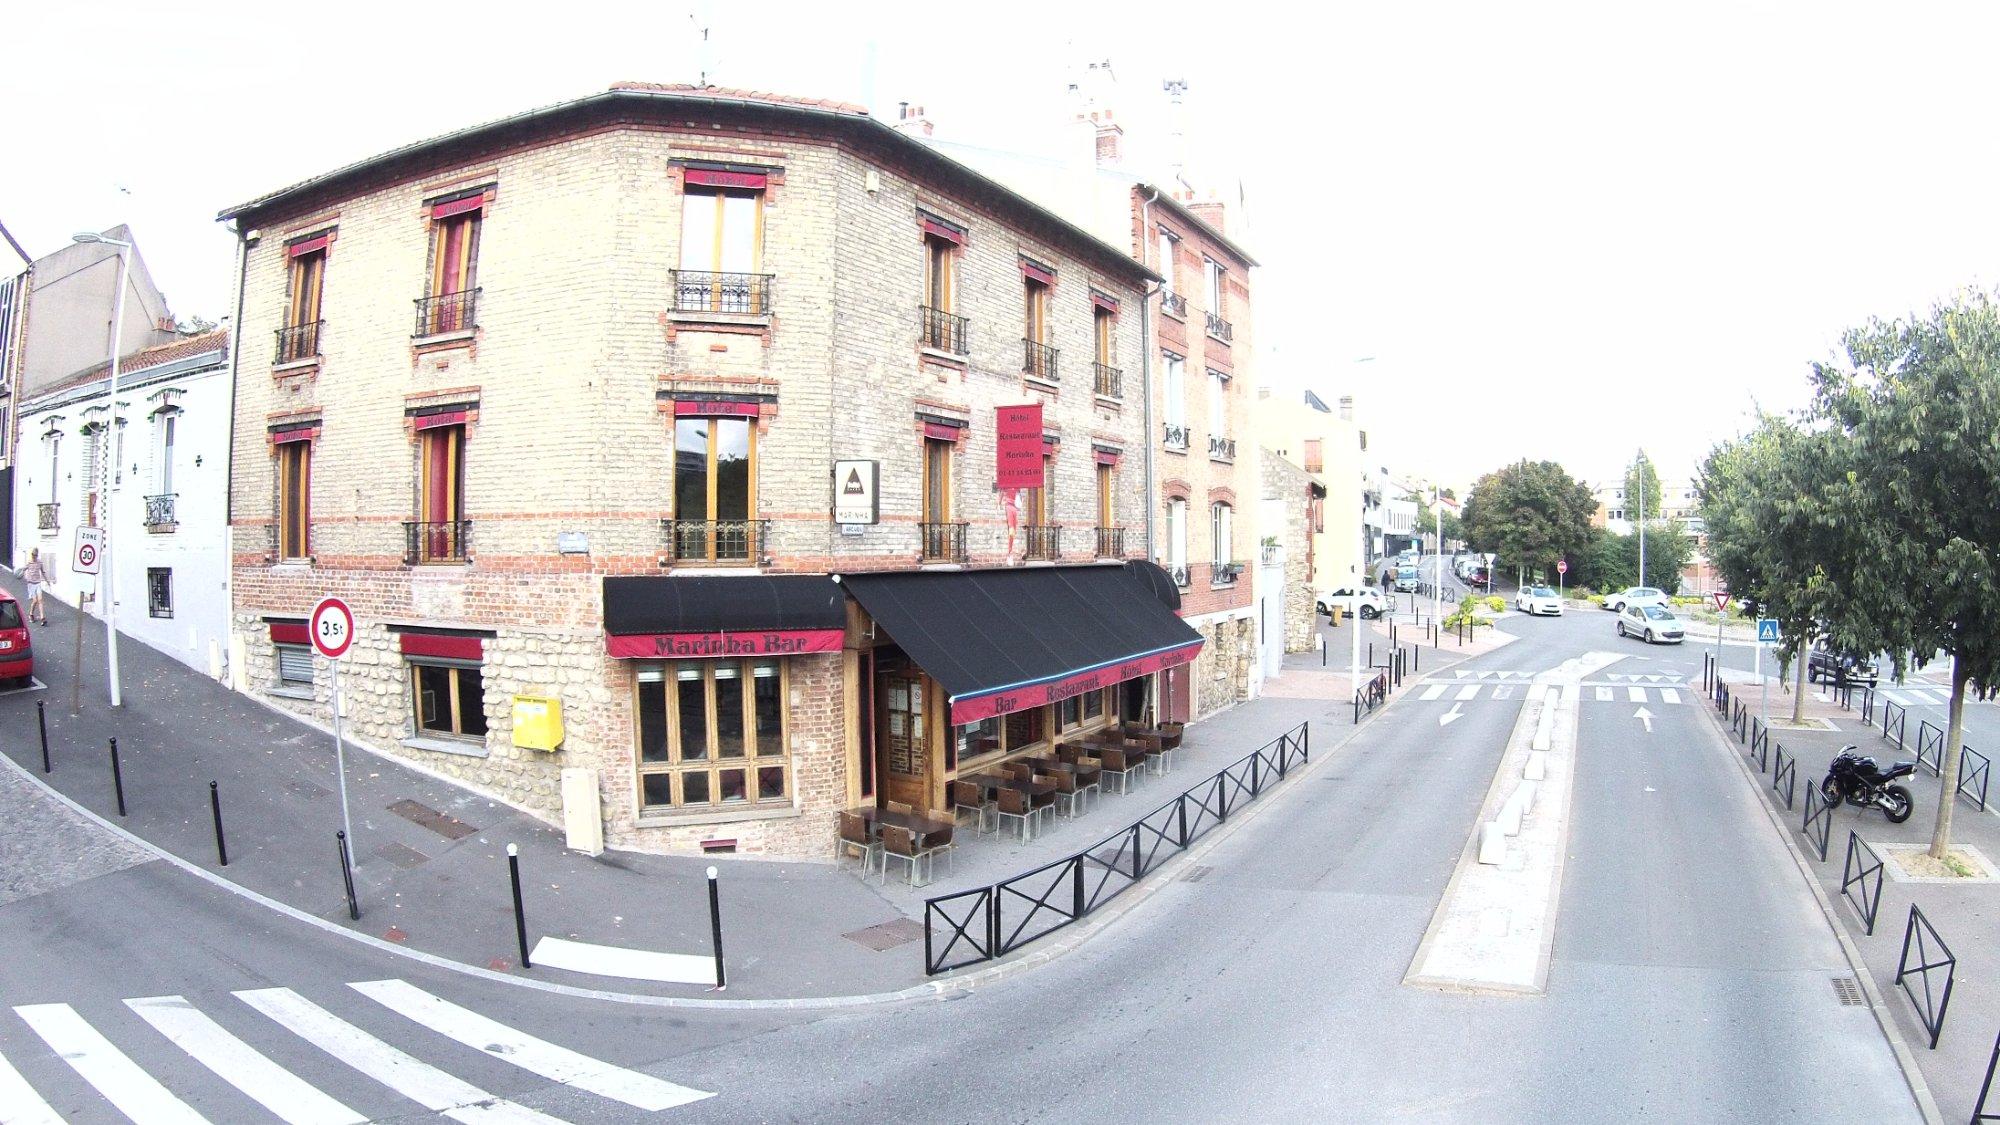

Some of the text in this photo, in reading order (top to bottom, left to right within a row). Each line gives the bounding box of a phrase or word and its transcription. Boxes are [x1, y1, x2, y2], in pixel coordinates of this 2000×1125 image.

[838, 511, 869, 520] MARINHA
[81, 532, 98, 541] ZONE
[82, 550, 93, 561] 30
[653, 633, 808, 657] Marinha Bar
[994, 696, 1018, 715] Bar
[1045, 677, 1101, 703] Restaurant
